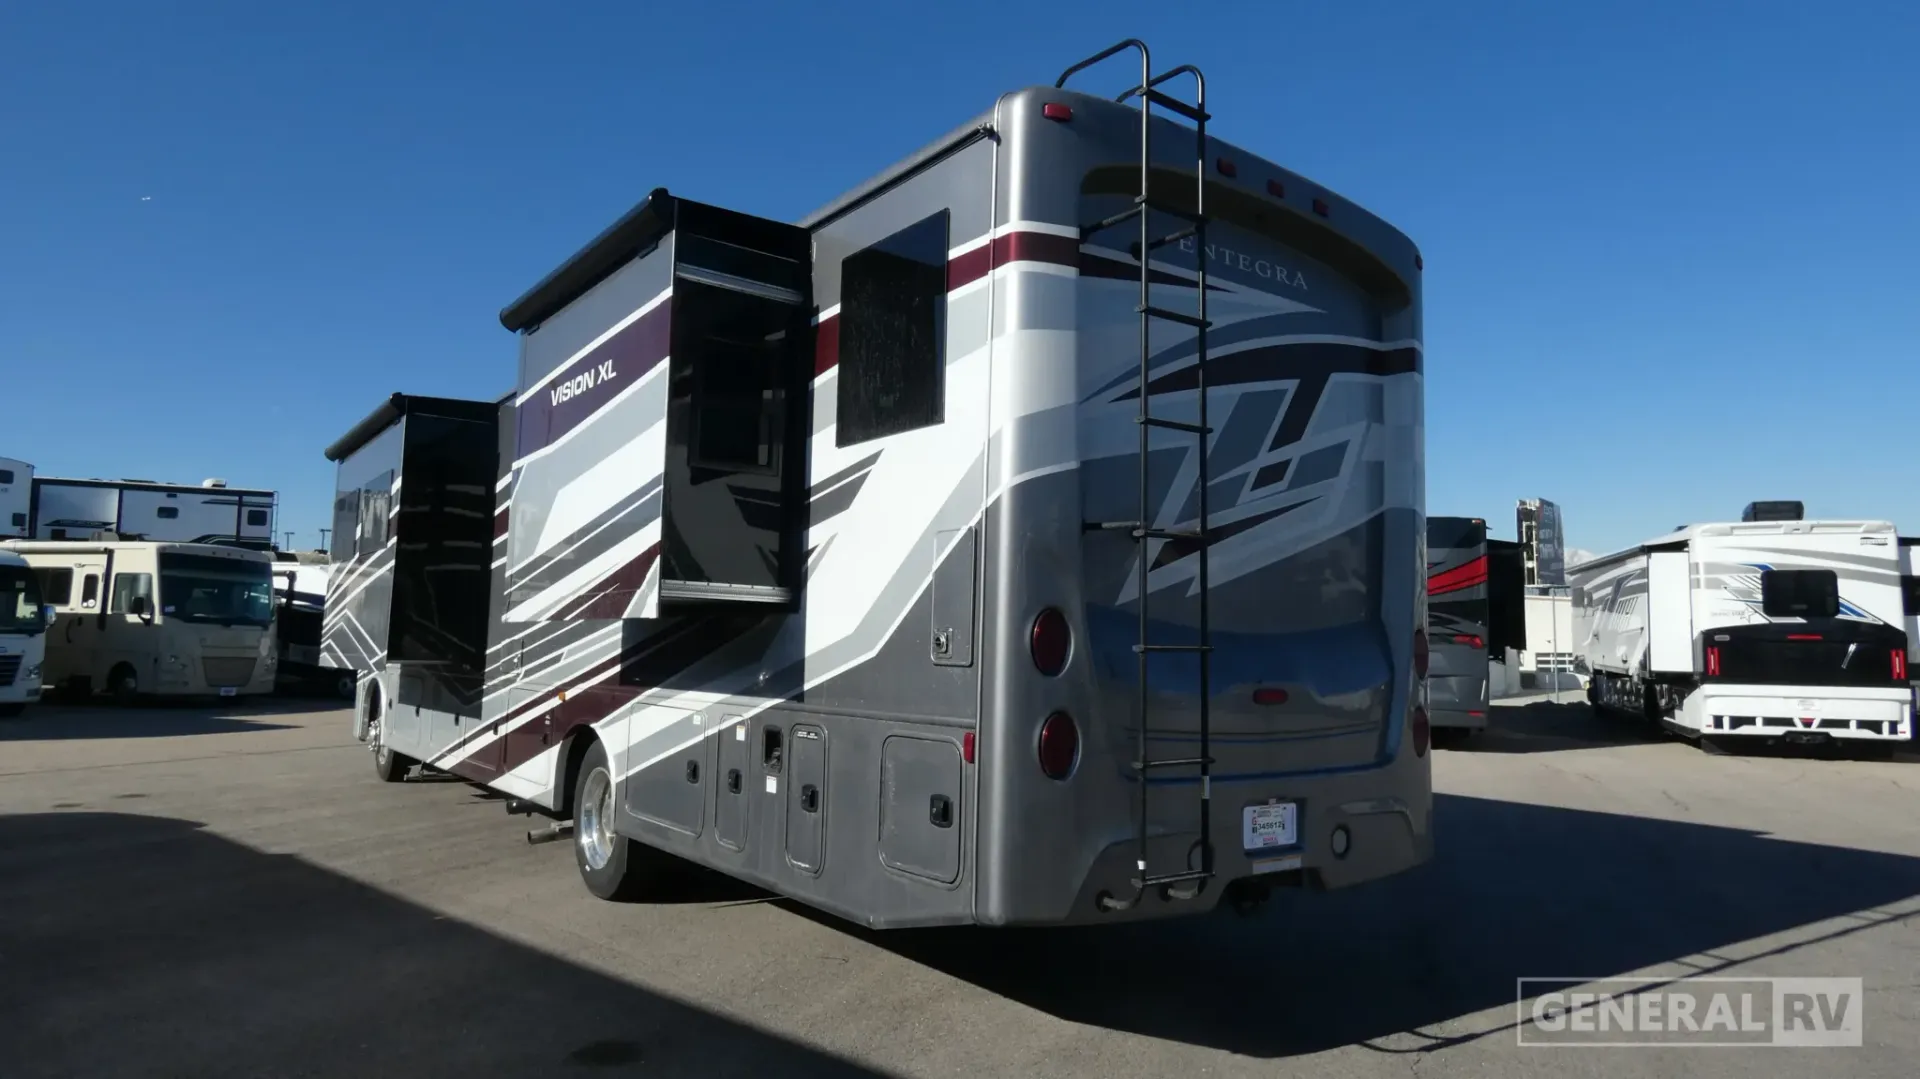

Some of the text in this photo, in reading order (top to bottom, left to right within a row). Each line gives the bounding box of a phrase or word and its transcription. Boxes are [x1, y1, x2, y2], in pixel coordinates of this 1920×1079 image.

[1179, 236, 1309, 290] ENTEGRA
[550, 359, 617, 407] VISION XL
